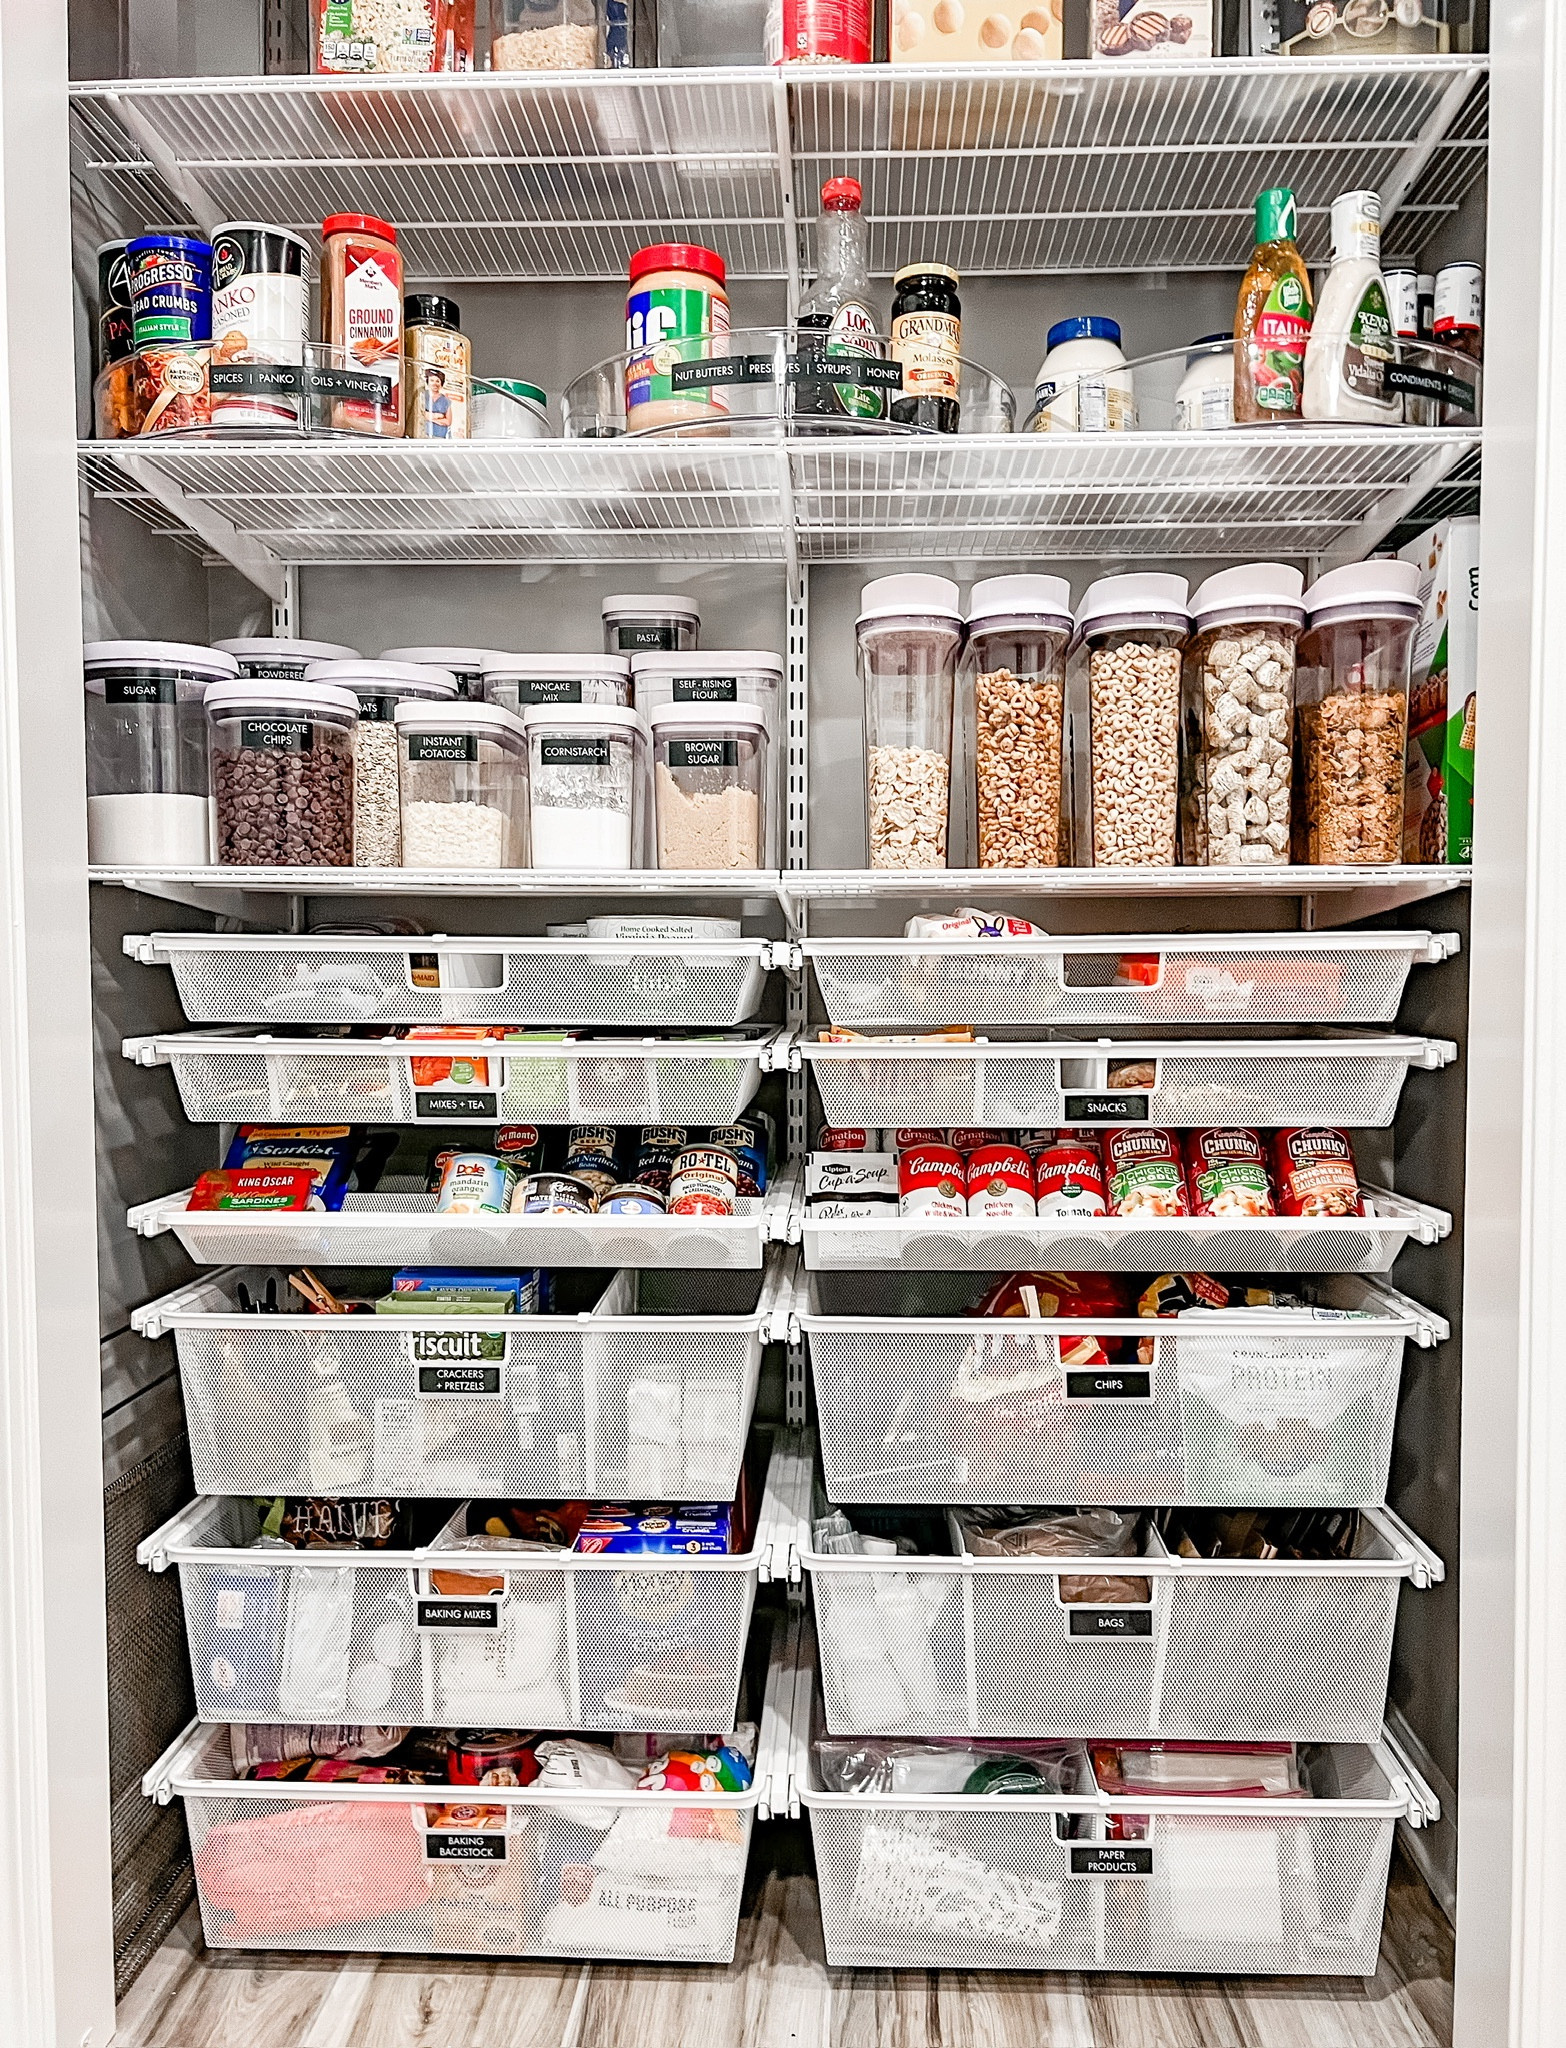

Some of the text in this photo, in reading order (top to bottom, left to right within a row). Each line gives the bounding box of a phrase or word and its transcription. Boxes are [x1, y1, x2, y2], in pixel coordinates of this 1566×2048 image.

[152, 295, 198, 314] CRUMBS
[349, 308, 394, 325] GROUND
[138, 324, 159, 333] ITALIAN
[160, 323, 179, 331] STYLE
[846, 310, 872, 335] LOG
[349, 326, 393, 339] CINNAMON
[912, 352, 954, 366] Molasses
[675, 370, 694, 382] NUT
[695, 365, 734, 378] BUTTERS
[816, 363, 852, 375] SYRUPS
[866, 366, 900, 380] HONEY
[916, 371, 950, 380] ORIGINAL
[169, 374, 200, 383] FAVORITE
[213, 373, 244, 384] SPICES
[258, 374, 295, 385] PANKO
[310, 376, 333, 387] OILS
[344, 379, 389, 395] VINEGAR
[1389, 372, 1442, 392] CONDIMENTS
[855, 388, 871, 404] Lite
[636, 633, 660, 643] PASTA
[257, 670, 305, 680] POWDERED
[123, 685, 157, 695] SUGAR
[530, 682, 571, 692] PANCAKE
[542, 694, 559, 702] MIX
[692, 690, 719, 700] FLOUR
[247, 721, 308, 734] CHOCOLATE
[262, 734, 293, 746] CHIPS
[422, 736, 463, 747] INSTANT
[544, 747, 608, 757] CORNSTARCH
[684, 743, 722, 752] BROWN
[419, 749, 467, 759] POTATOES
[687, 754, 720, 764] SUGAR
[620, 925, 693, 934] Home Cooked Salted
[941, 917, 972, 931] Original
[429, 1099, 458, 1110] MIXES
[468, 1100, 485, 1110] TEA
[1086, 1102, 1128, 1113] SNACKS
[323, 1128, 347, 1136] Protein
[508, 1131, 536, 1140] Monte
[570, 1126, 616, 1143] BUSH'S
[642, 1126, 686, 1144] BUSH'S
[711, 1128, 753, 1147] BUSH'S
[821, 1128, 865, 1148] Carnation
[260, 1145, 334, 1156] StarKist
[1113, 1137, 1167, 1157] CHUNKY
[1204, 1138, 1257, 1155] CHUNKY
[1291, 1138, 1346, 1155] CHUNKY
[582, 1154, 619, 1171] Northern
[638, 1157, 656, 1168] Red
[738, 1159, 754, 1170] ans
[457, 1163, 486, 1175] Dole
[1126, 1166, 1178, 1180] CHICKEN
[1219, 1168, 1267, 1179] CHICKEN
[683, 1172, 724, 1182] Original
[1128, 1174, 1180, 1187] NOODLE
[1293, 1167, 1343, 1184] CHICKEN
[237, 1176, 294, 1187] KING OSCAR
[449, 1178, 489, 1187] mandarin
[1295, 1175, 1332, 1193] SAUSAGE
[231, 1197, 288, 1205] SARDINES
[984, 1202, 1014, 1210] Chicken
[1055, 1207, 1093, 1218] Tomato
[412, 1331, 483, 1357] riscuit
[436, 1369, 484, 1379] CRACKERS
[444, 1381, 485, 1391] PRETZELS
[1094, 1379, 1124, 1390] CHIPS
[689, 1541, 697, 1552] 3
[425, 1608, 492, 1620] BAKING MIXES
[1098, 1618, 1125, 1628] BAGS
[447, 1836, 485, 1846] BAKING
[439, 1847, 495, 1858] BACKSTOCK
[1098, 1850, 1126, 1860] PAPER
[1087, 1861, 1137, 1872] PRODUCTS
